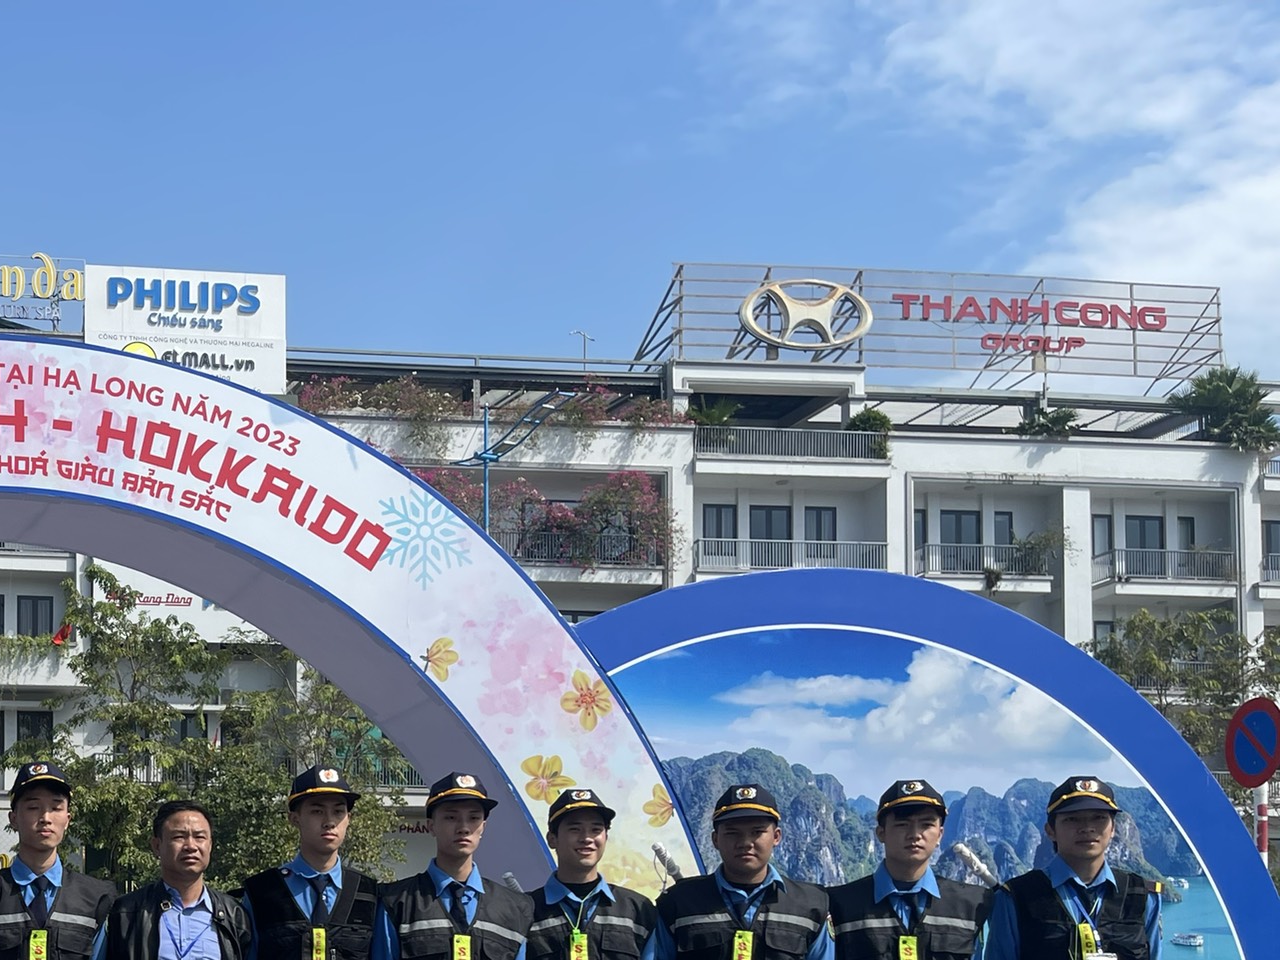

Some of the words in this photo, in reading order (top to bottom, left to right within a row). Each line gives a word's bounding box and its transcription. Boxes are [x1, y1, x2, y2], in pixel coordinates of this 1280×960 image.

[106, 276, 261, 315] PHILIPS
[35, 306, 62, 320] SPA
[147, 312, 187, 329] Chiếu
[189, 314, 223, 332] sáng
[980, 333, 1086, 353] GROUP
[43, 366, 81, 396] HẠ
[90, 373, 164, 407] LONG
[172, 391, 233, 429] NĂM
[237, 416, 302, 457] 2023
[96, 410, 393, 572] HOKKAIDO
